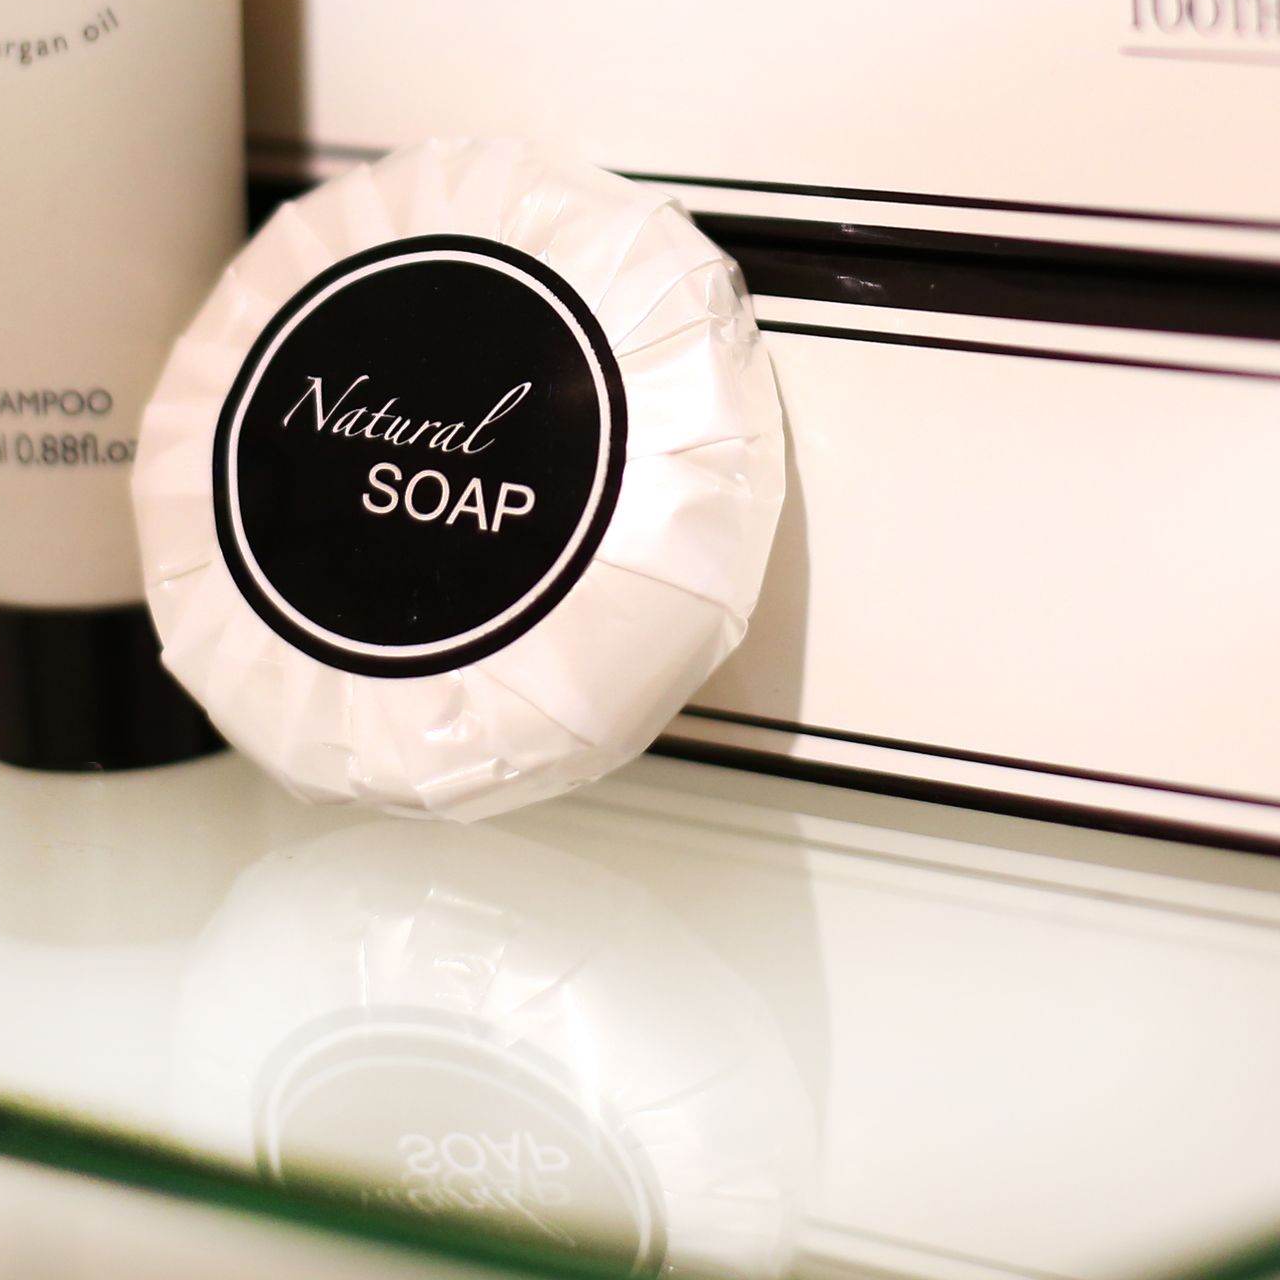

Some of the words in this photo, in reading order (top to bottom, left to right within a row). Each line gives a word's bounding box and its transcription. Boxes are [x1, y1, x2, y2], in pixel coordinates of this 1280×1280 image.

[81, 6, 120, 43] oil
[282, 373, 533, 454] Natural
[361, 461, 536, 533] SOAP
